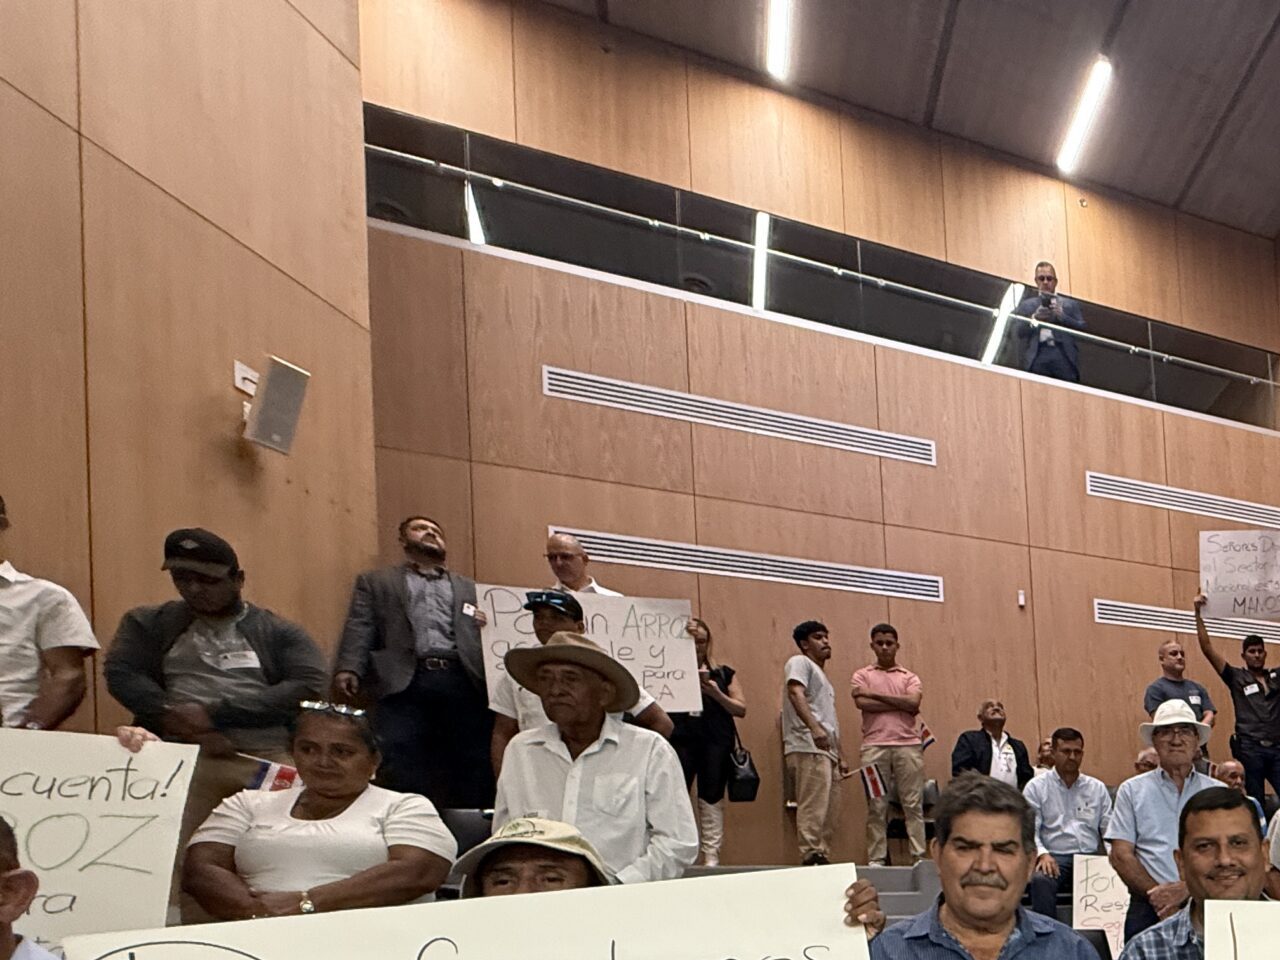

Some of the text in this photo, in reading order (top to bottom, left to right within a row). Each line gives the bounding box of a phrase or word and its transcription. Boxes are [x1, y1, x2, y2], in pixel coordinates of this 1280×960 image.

[644, 645, 665, 668] y
[642, 669, 686, 689] para
[0, 757, 184, 801] cuenta!
